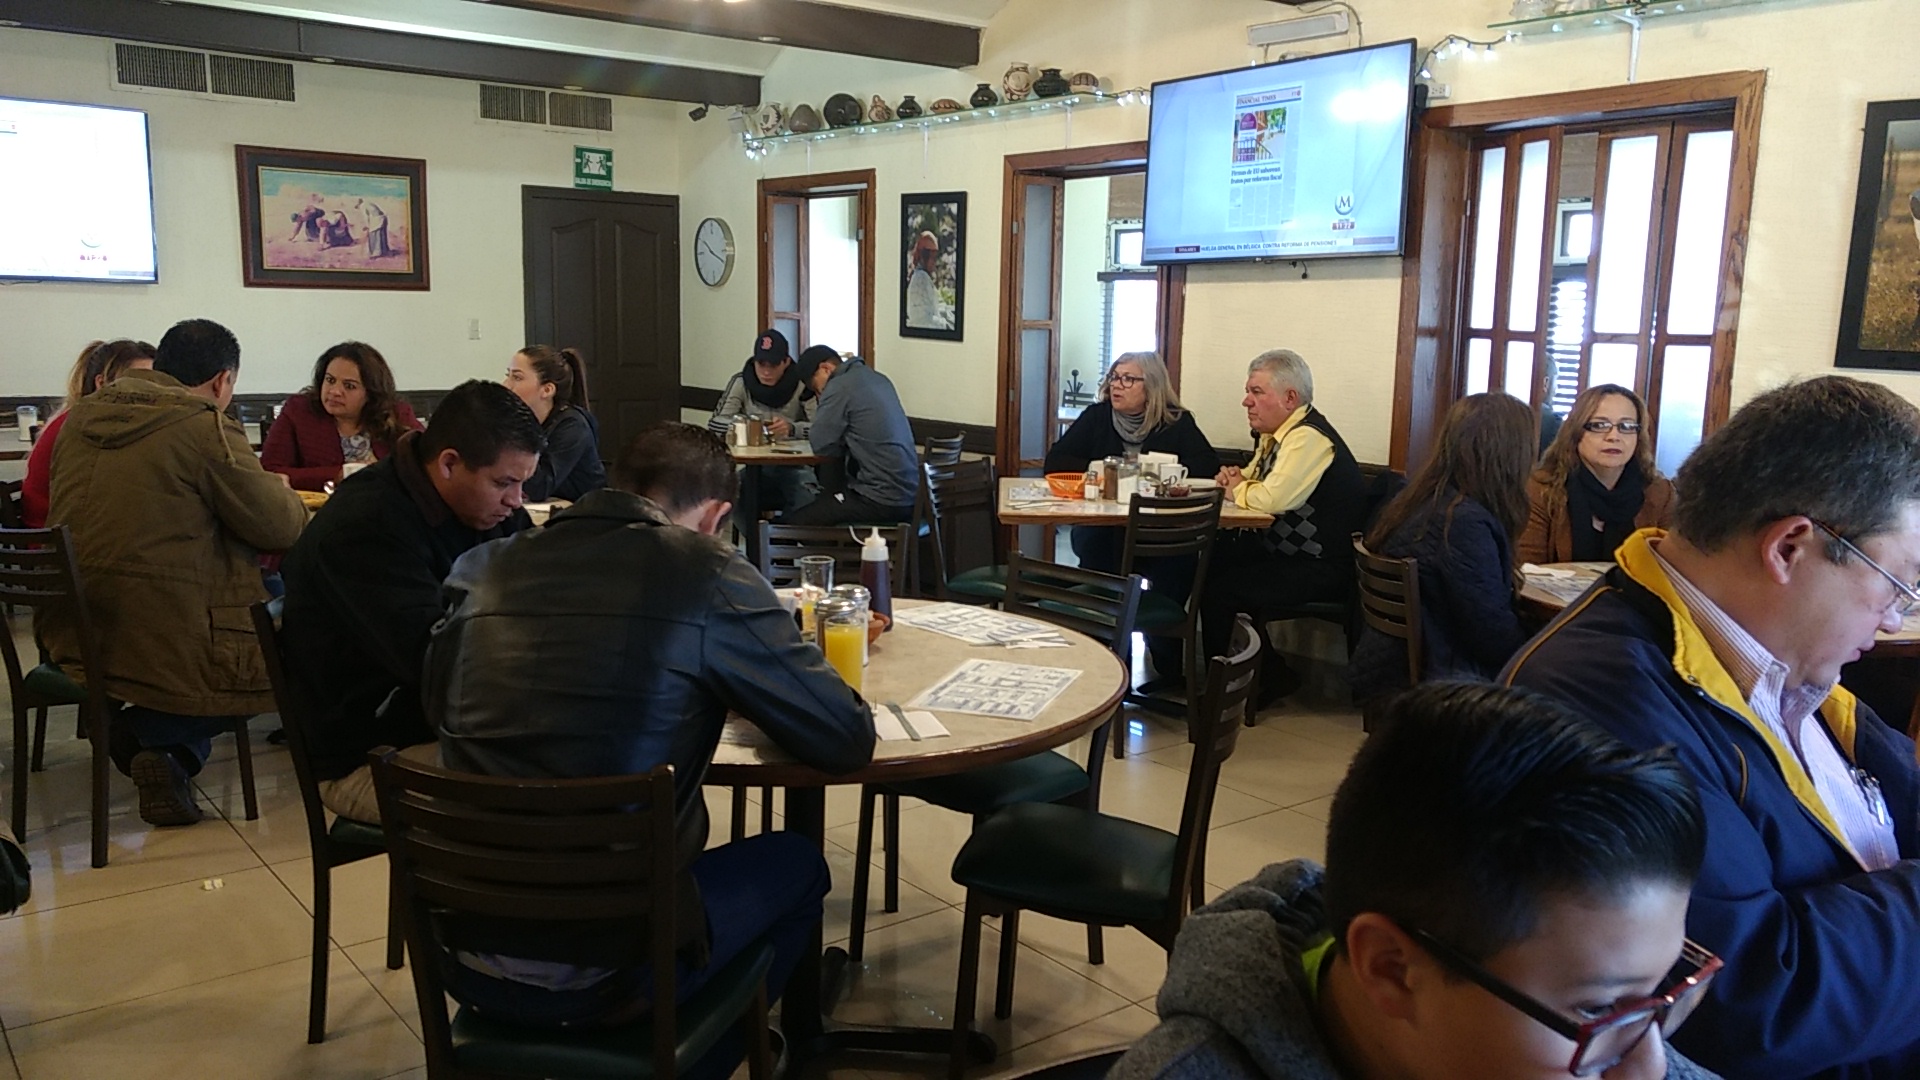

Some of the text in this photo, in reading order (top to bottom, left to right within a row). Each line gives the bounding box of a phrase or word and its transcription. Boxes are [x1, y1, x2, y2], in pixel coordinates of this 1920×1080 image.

[1262, 94, 1277, 102] TIMES
[1243, 177, 1251, 185] por
[1270, 173, 1283, 181] fiscal
